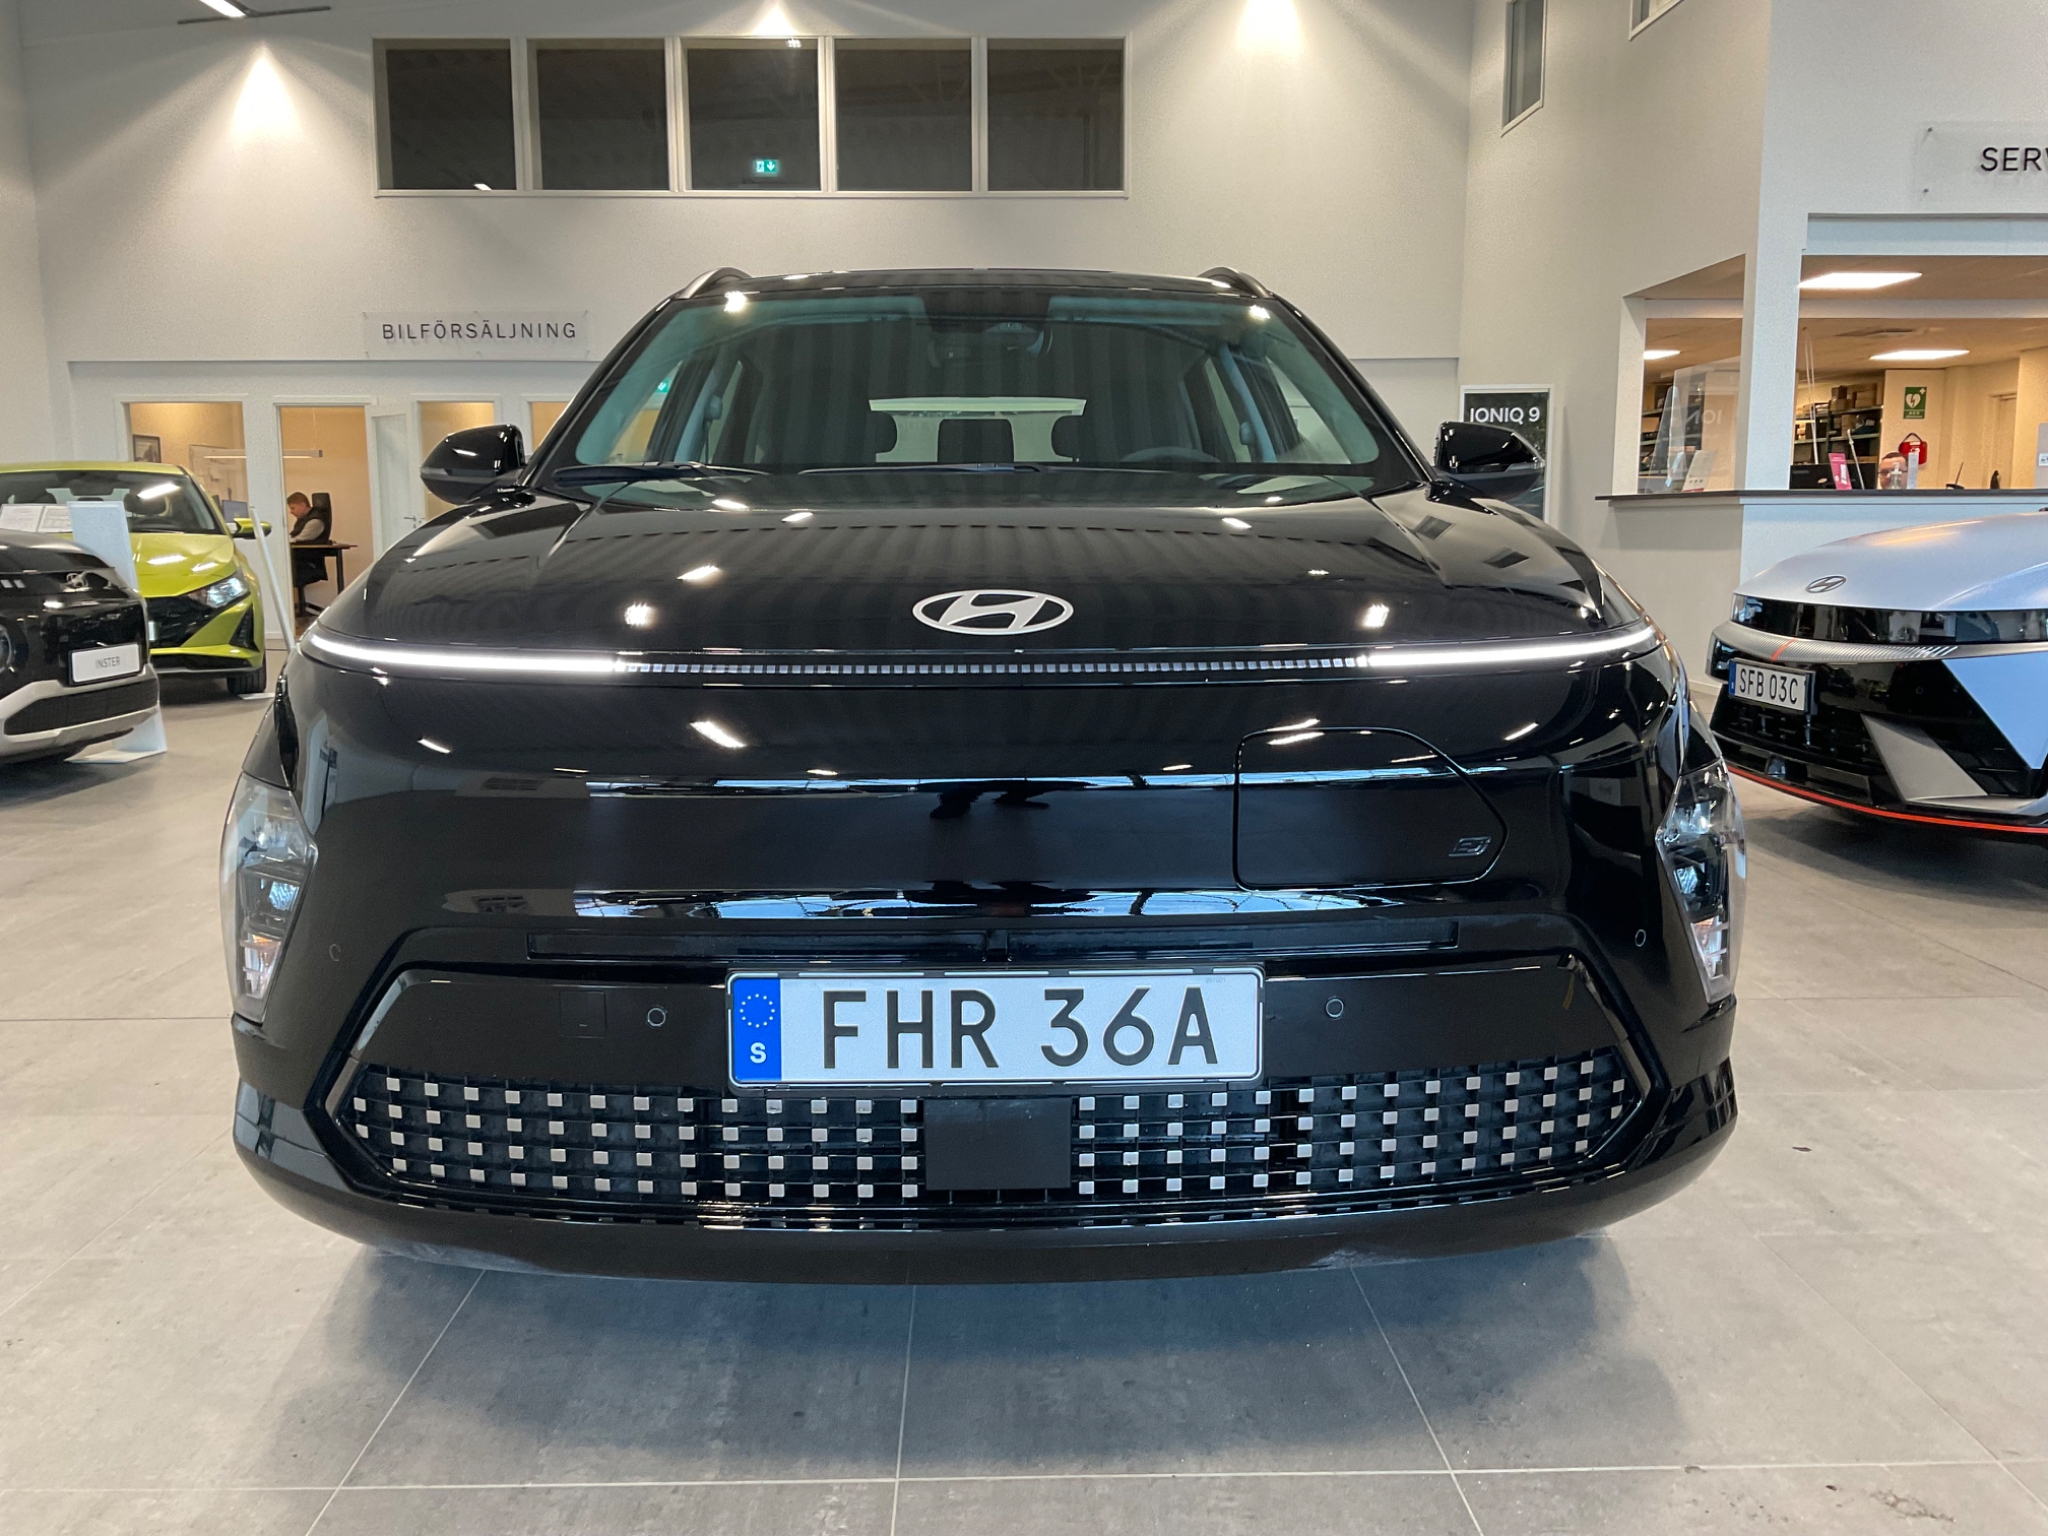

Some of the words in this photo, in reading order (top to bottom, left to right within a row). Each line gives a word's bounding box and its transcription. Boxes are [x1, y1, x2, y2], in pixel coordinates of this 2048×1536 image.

[1980, 147, 2048, 171] SER
[382, 320, 576, 339] BILFÖRSÄLJNING
[1470, 407, 1524, 425] IONIQ
[1528, 407, 1541, 422] 9
[95, 656, 121, 669] INSTER
[1740, 668, 1764, 697] SFB
[1769, 674, 1798, 704] 03C
[823, 990, 999, 1069] FHR
[1041, 987, 1218, 1067] 36A
[750, 1042, 766, 1063] S
